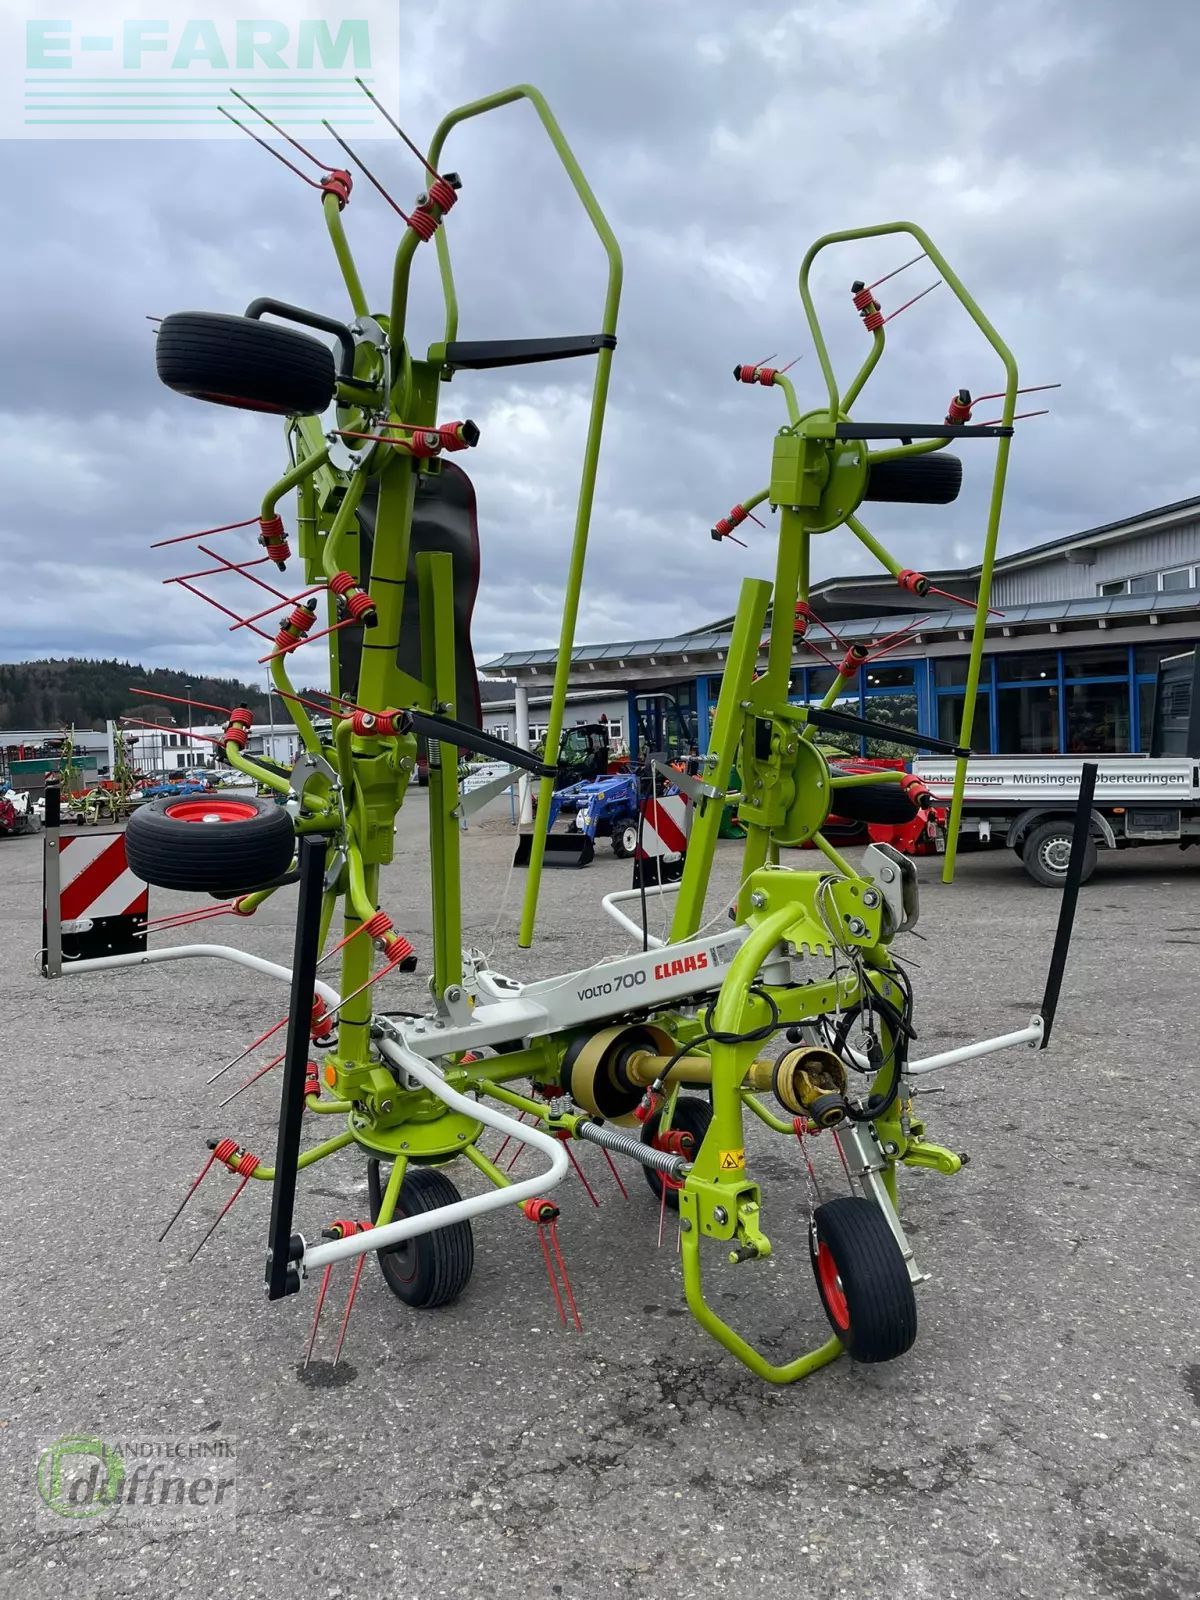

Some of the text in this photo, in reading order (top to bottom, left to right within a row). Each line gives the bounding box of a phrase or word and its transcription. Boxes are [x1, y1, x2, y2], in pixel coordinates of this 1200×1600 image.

[923, 774, 1004, 786] Hoheengen
[1013, 774, 1081, 787] Münsingen
[577, 983, 612, 1001] VOLTO
[613, 970, 647, 992] 700
[654, 952, 708, 980] CLAAS
